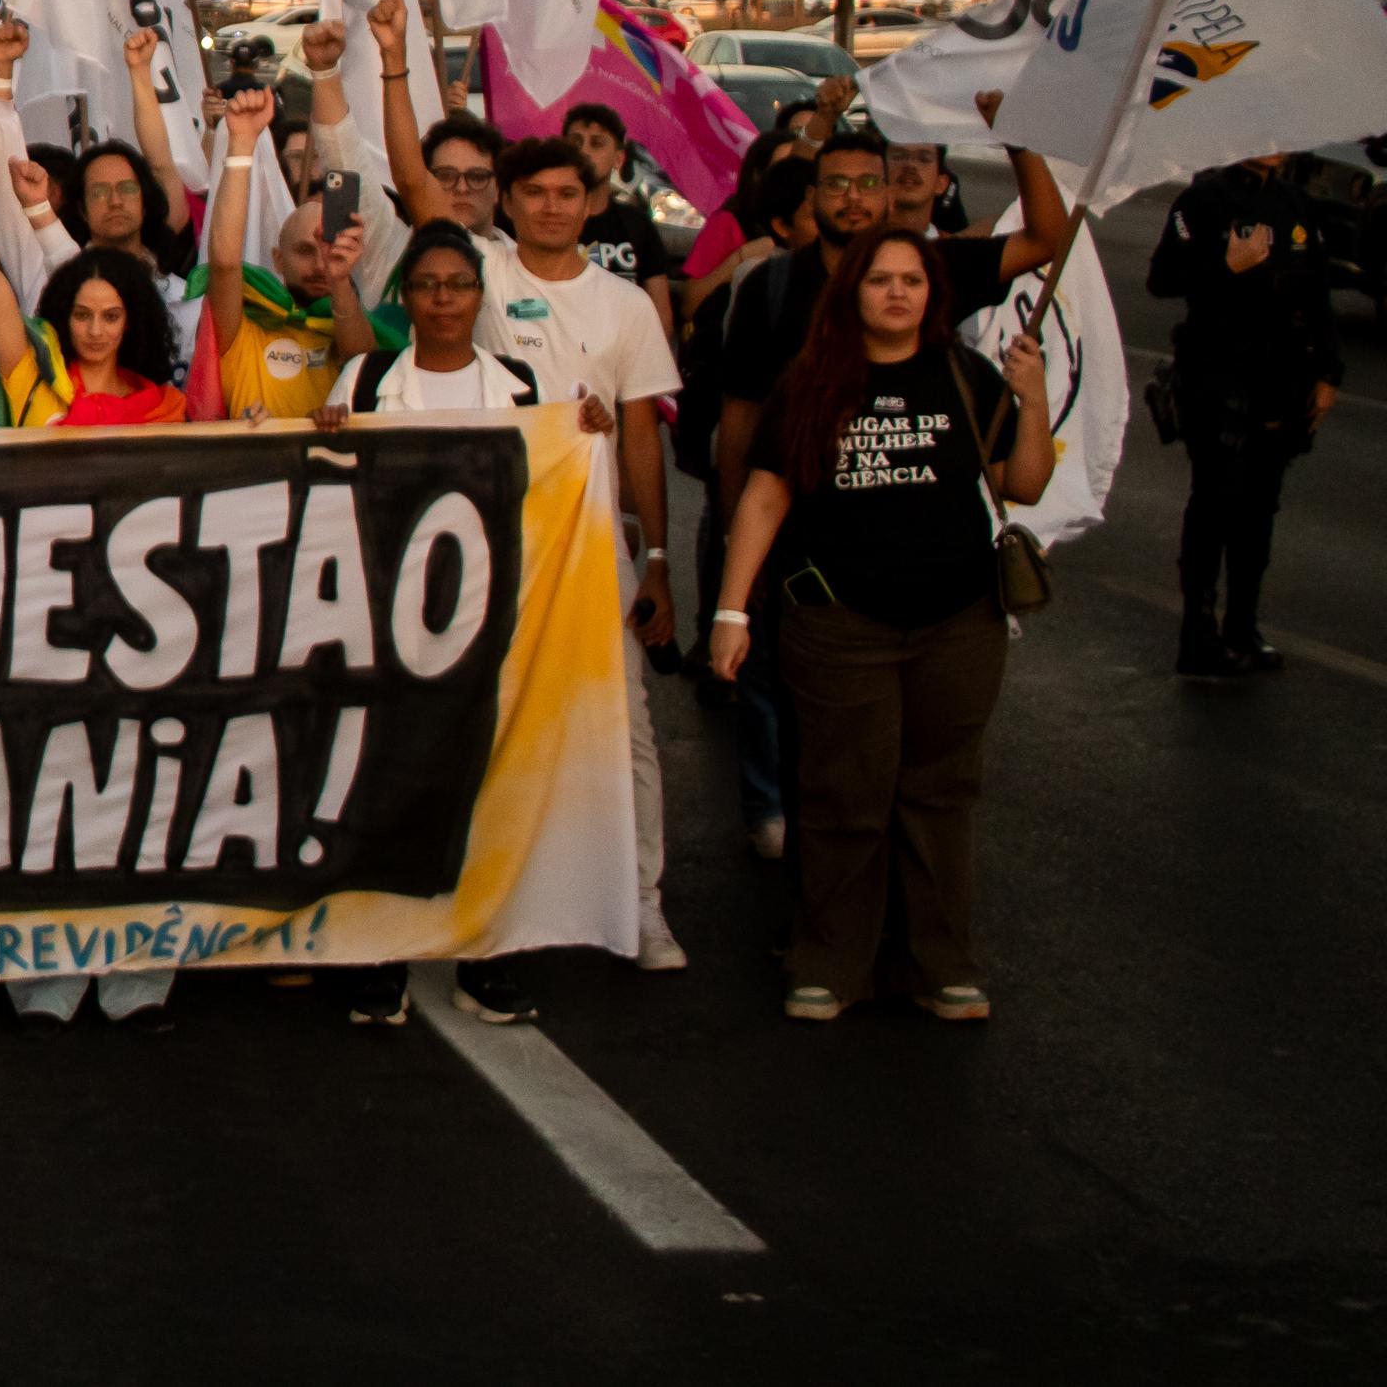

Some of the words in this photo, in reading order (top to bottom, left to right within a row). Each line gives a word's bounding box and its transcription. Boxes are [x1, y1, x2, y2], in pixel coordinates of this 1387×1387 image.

[266, 350, 303, 366] ANPG
[849, 417, 911, 433] UGAR
[917, 414, 950, 430] DE
[856, 452, 890, 468] NA
[835, 465, 937, 490] CIÊNCIA
